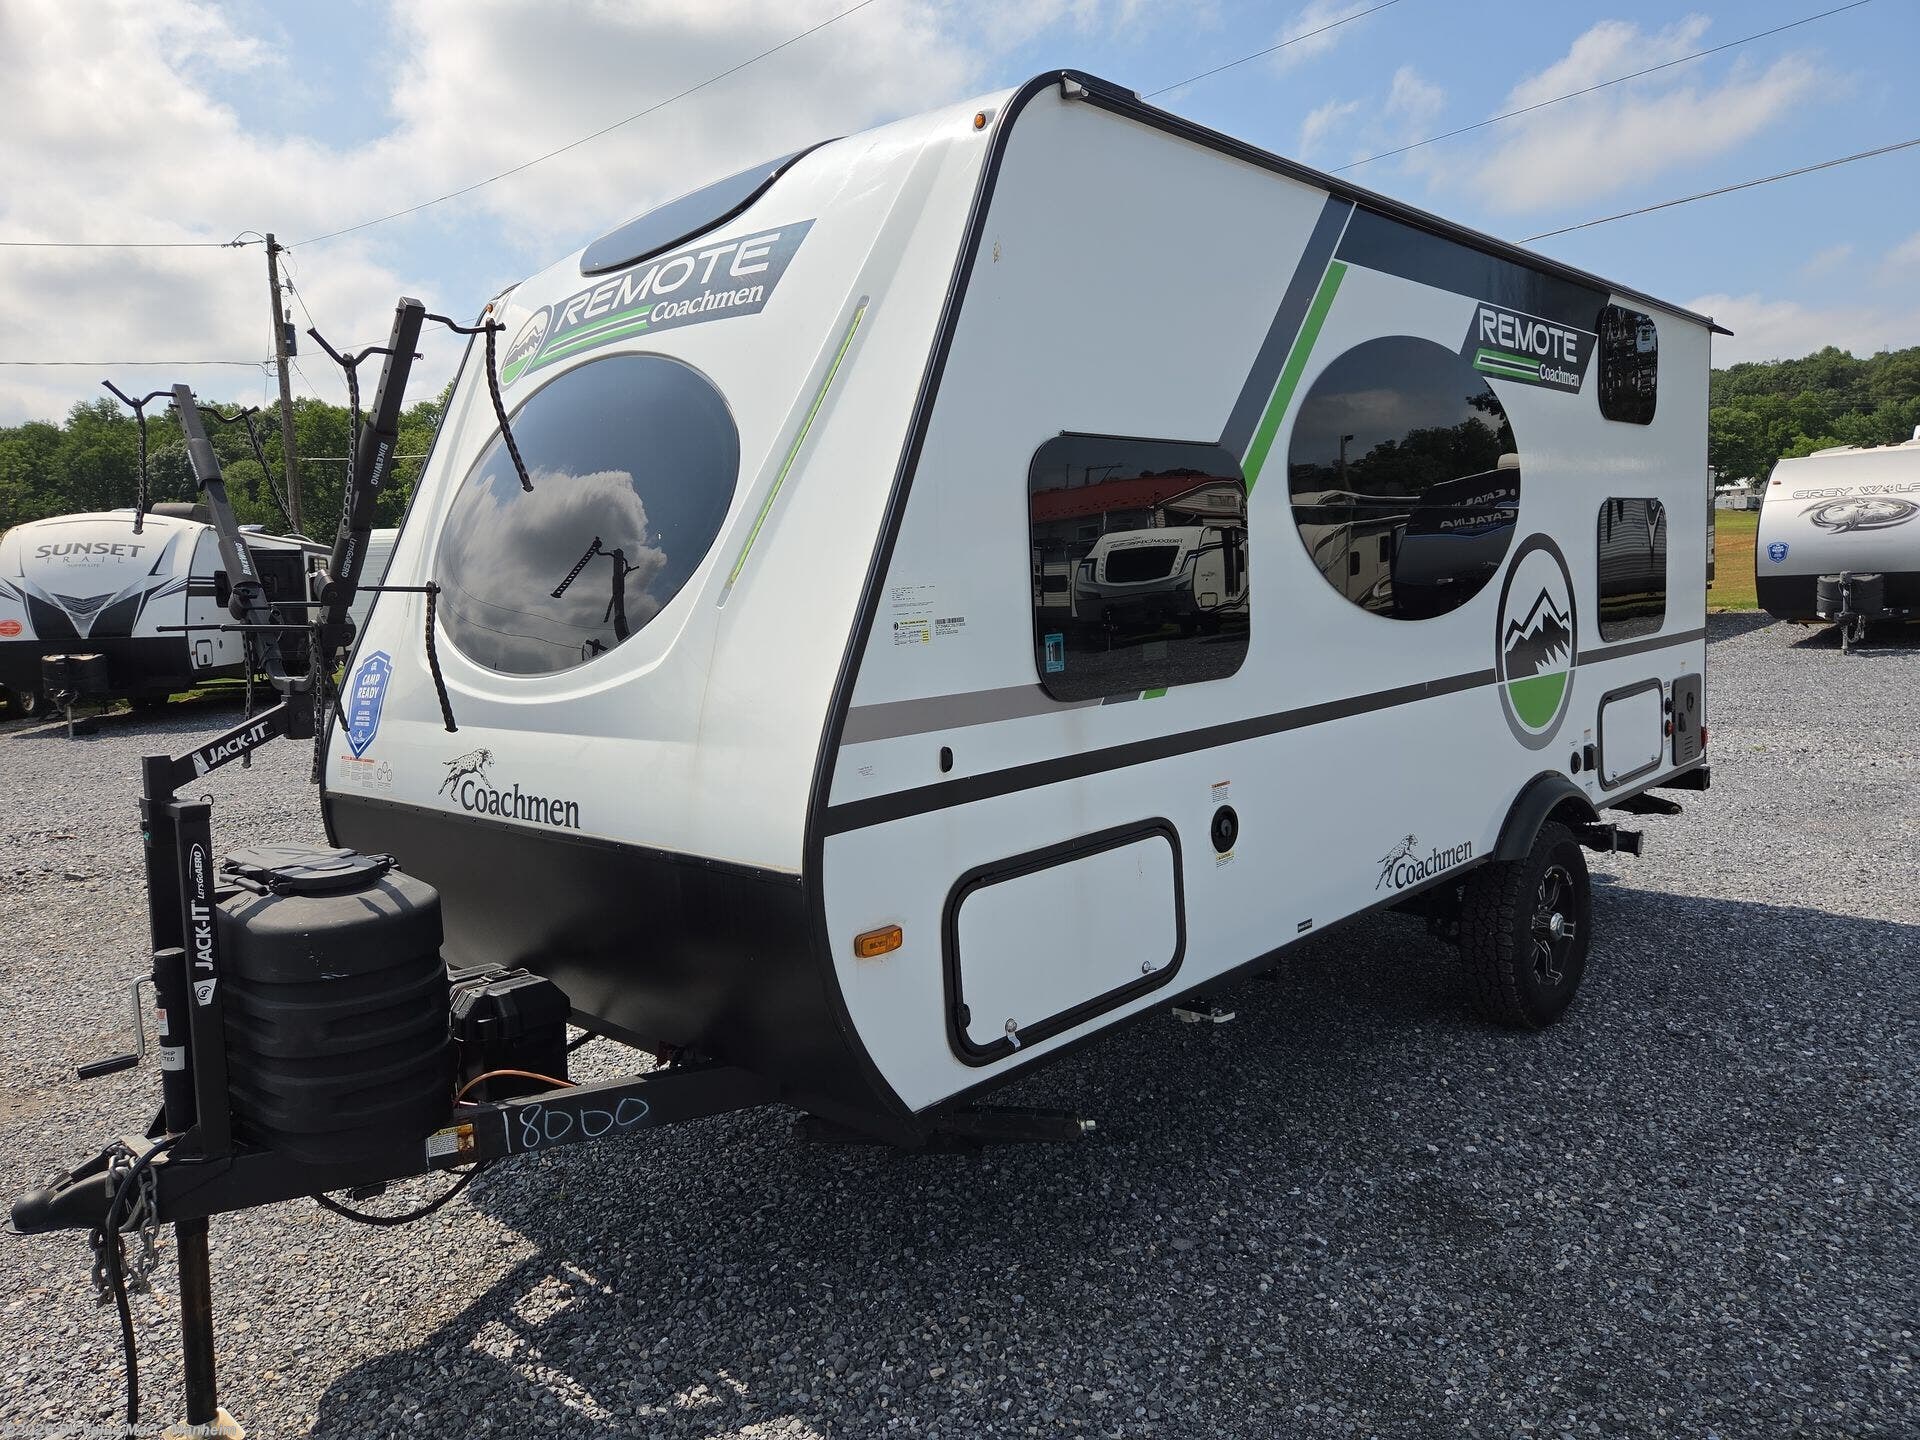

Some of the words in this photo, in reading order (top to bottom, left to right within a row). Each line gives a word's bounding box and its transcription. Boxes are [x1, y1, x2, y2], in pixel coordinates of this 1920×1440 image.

[553, 232, 781, 332] REMOTE
[650, 284, 763, 323] Coachmen
[1479, 308, 1578, 363] REMOTE
[1539, 363, 1580, 387] Coachmen
[1793, 487, 1854, 499] GREY
[35, 543, 145, 559] SUNSET
[46, 556, 126, 564] TRAIL
[357, 687, 379, 699] READY
[362, 673, 381, 686] CAMP
[209, 721, 268, 765] JACK-IT
[460, 780, 580, 829] Coachmen
[1395, 840, 1473, 889] Coachmen
[191, 901, 214, 970] JACK-IT
[502, 1098, 649, 1154] 18000
